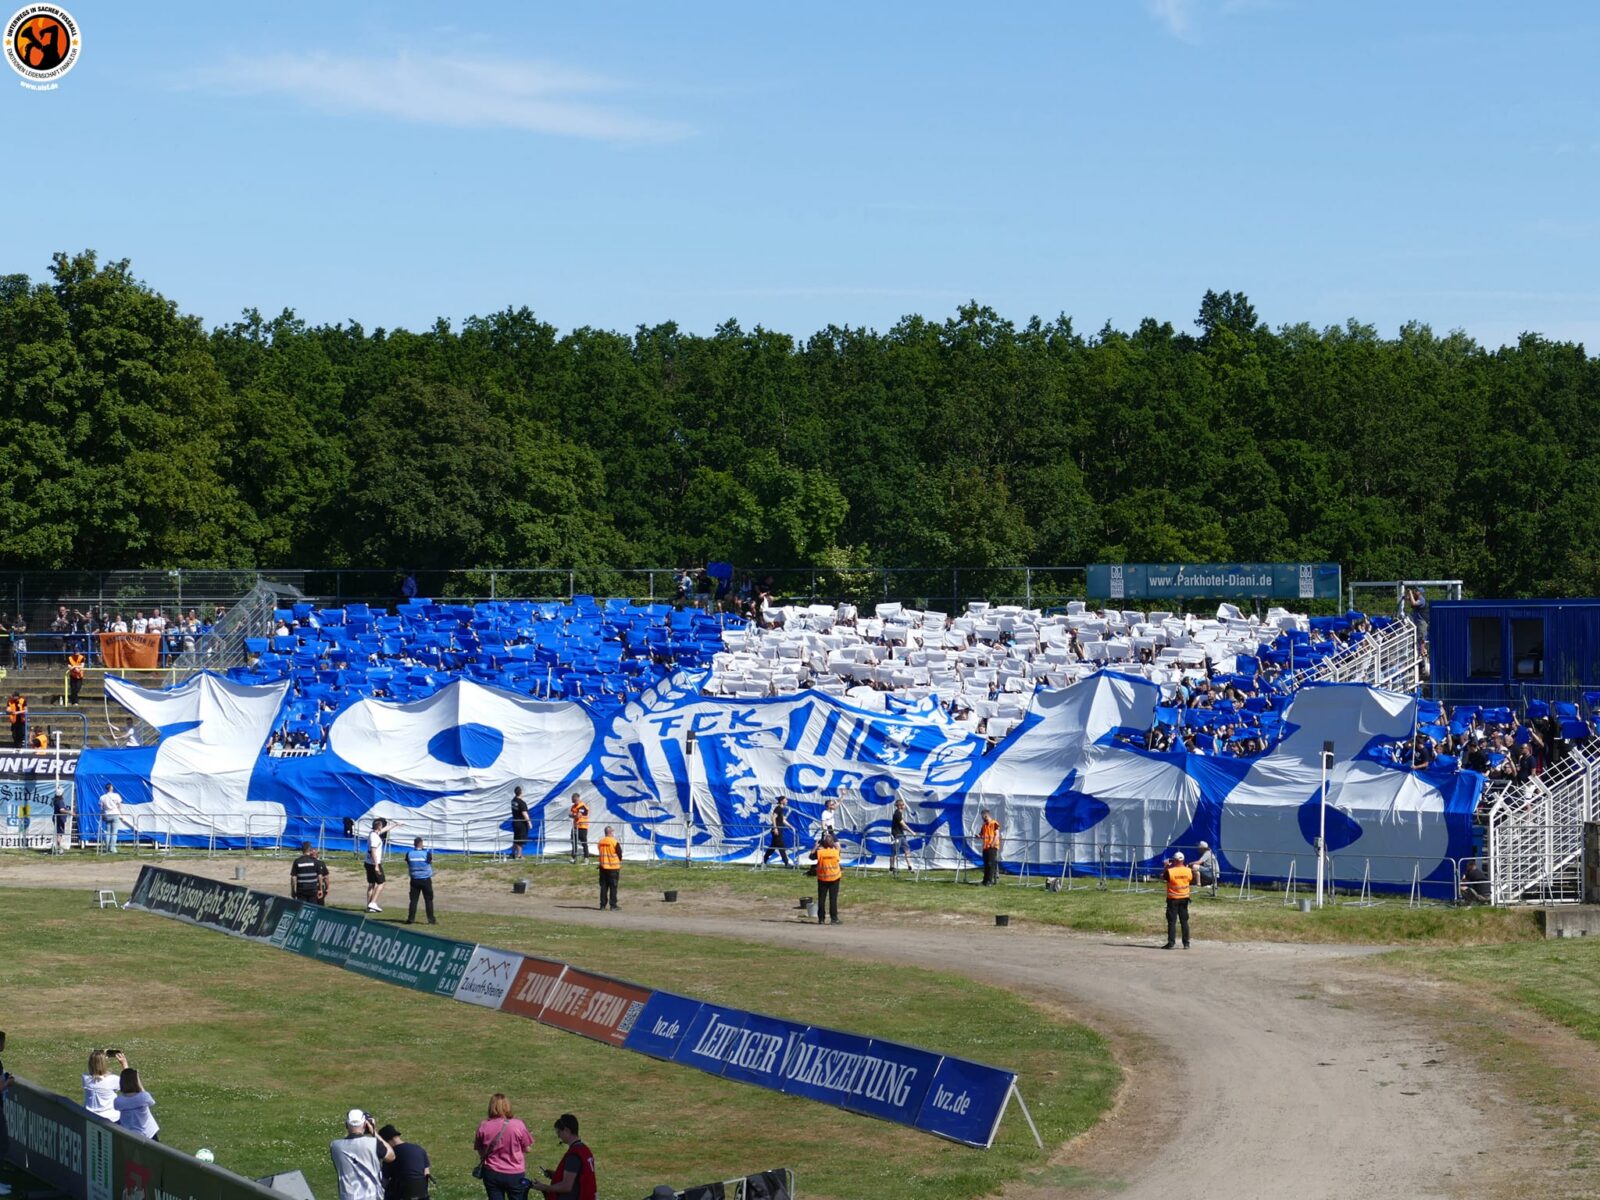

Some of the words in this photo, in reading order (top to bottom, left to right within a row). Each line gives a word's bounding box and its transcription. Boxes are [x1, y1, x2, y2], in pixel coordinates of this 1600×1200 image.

[1149, 573, 1273, 587] www.Parkhotel-Diani.de
[784, 763, 900, 806] CFC
[148, 872, 178, 901] Unsere
[195, 885, 225, 922] geht
[218, 891, 242, 920] 365
[311, 918, 446, 975] WWW.REPROBAU.DE
[581, 992, 628, 1028] STEIN
[652, 1016, 680, 1040] lvz.de
[778, 1031, 918, 1107] VOLKSZEITUNG
[932, 1083, 971, 1116] lvz.de
[28, 1111, 58, 1161] HUBERT
[59, 1124, 82, 1175] BEYER
